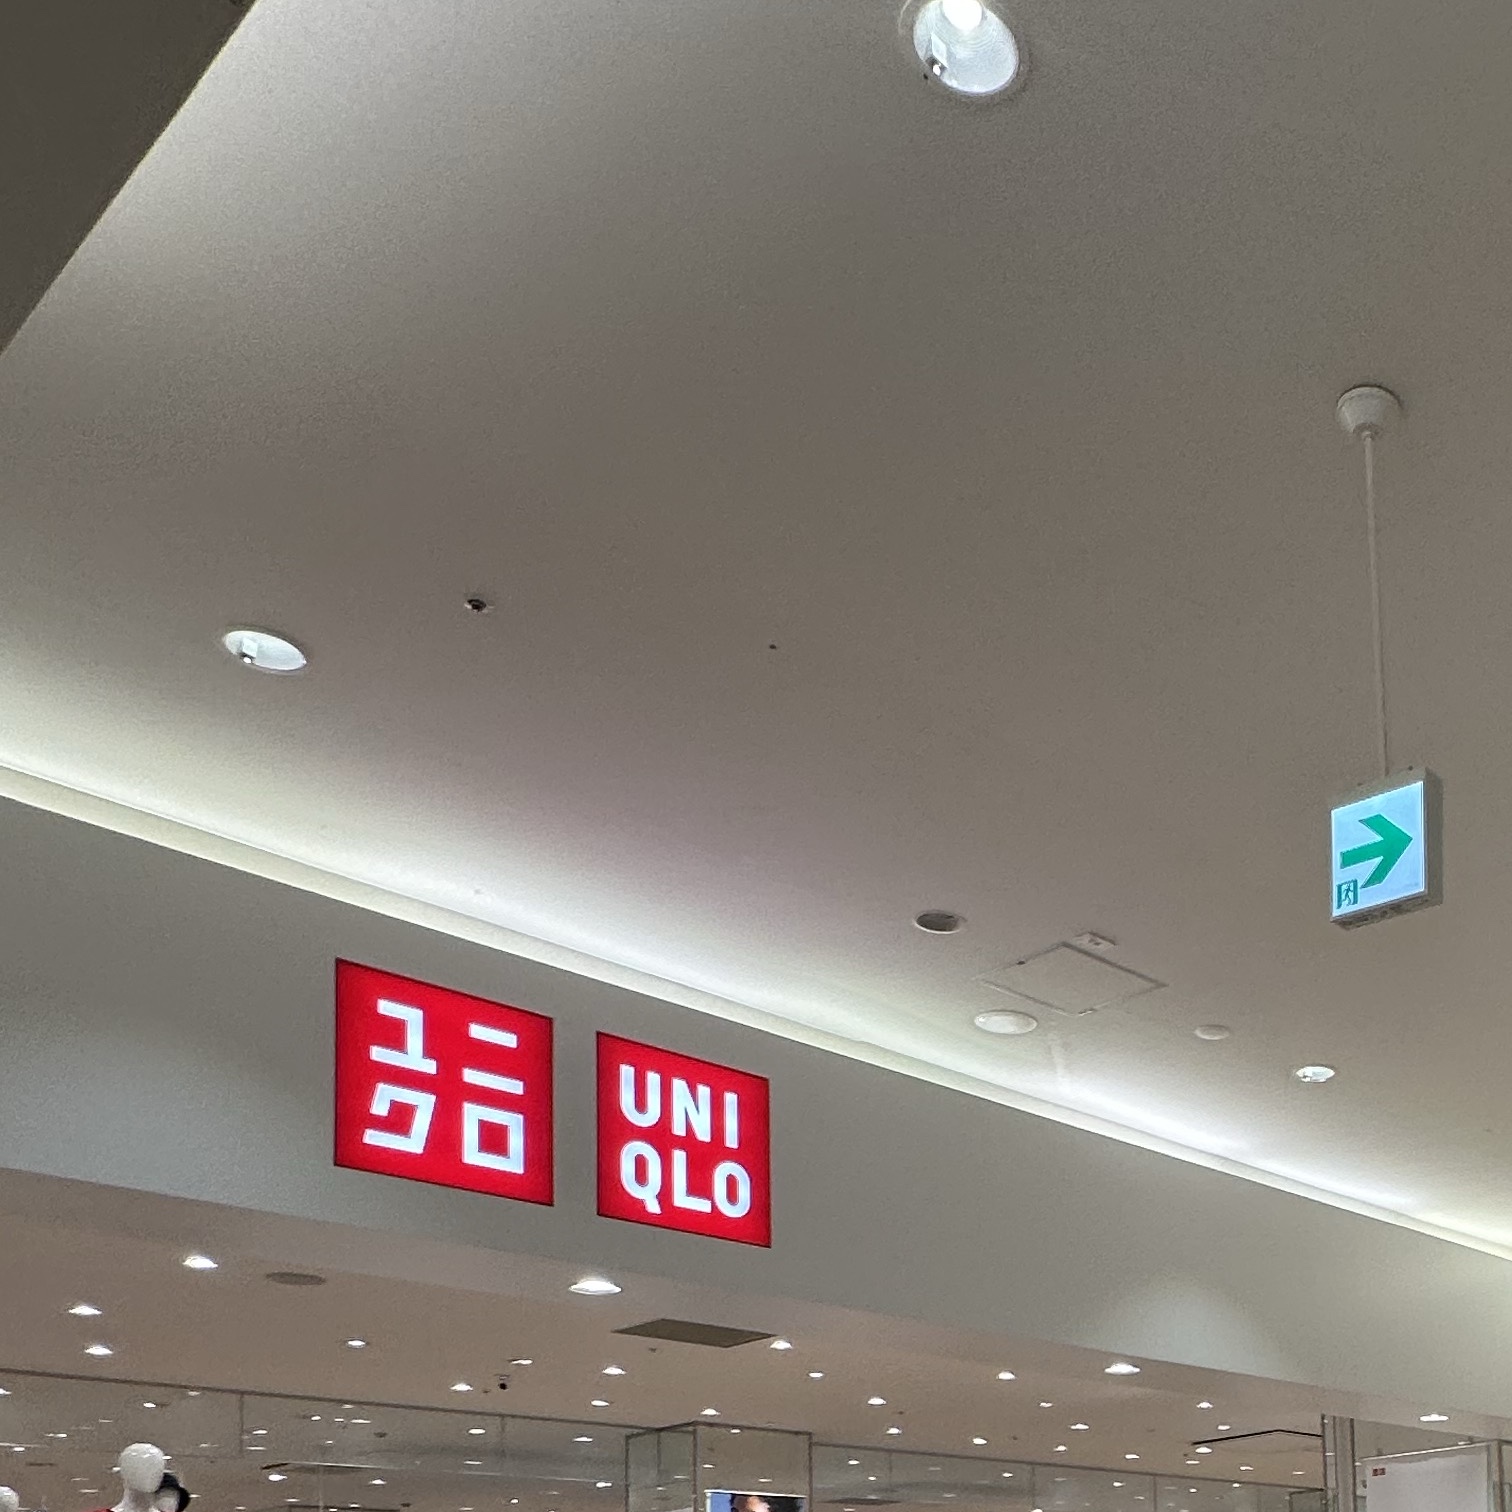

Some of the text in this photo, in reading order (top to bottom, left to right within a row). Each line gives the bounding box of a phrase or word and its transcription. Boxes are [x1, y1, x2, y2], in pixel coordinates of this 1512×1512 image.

[369, 998, 525, 1095] ユニ
[362, 1082, 526, 1174] クロ
[619, 1063, 740, 1149] UNI
[619, 1140, 752, 1218] QLO
